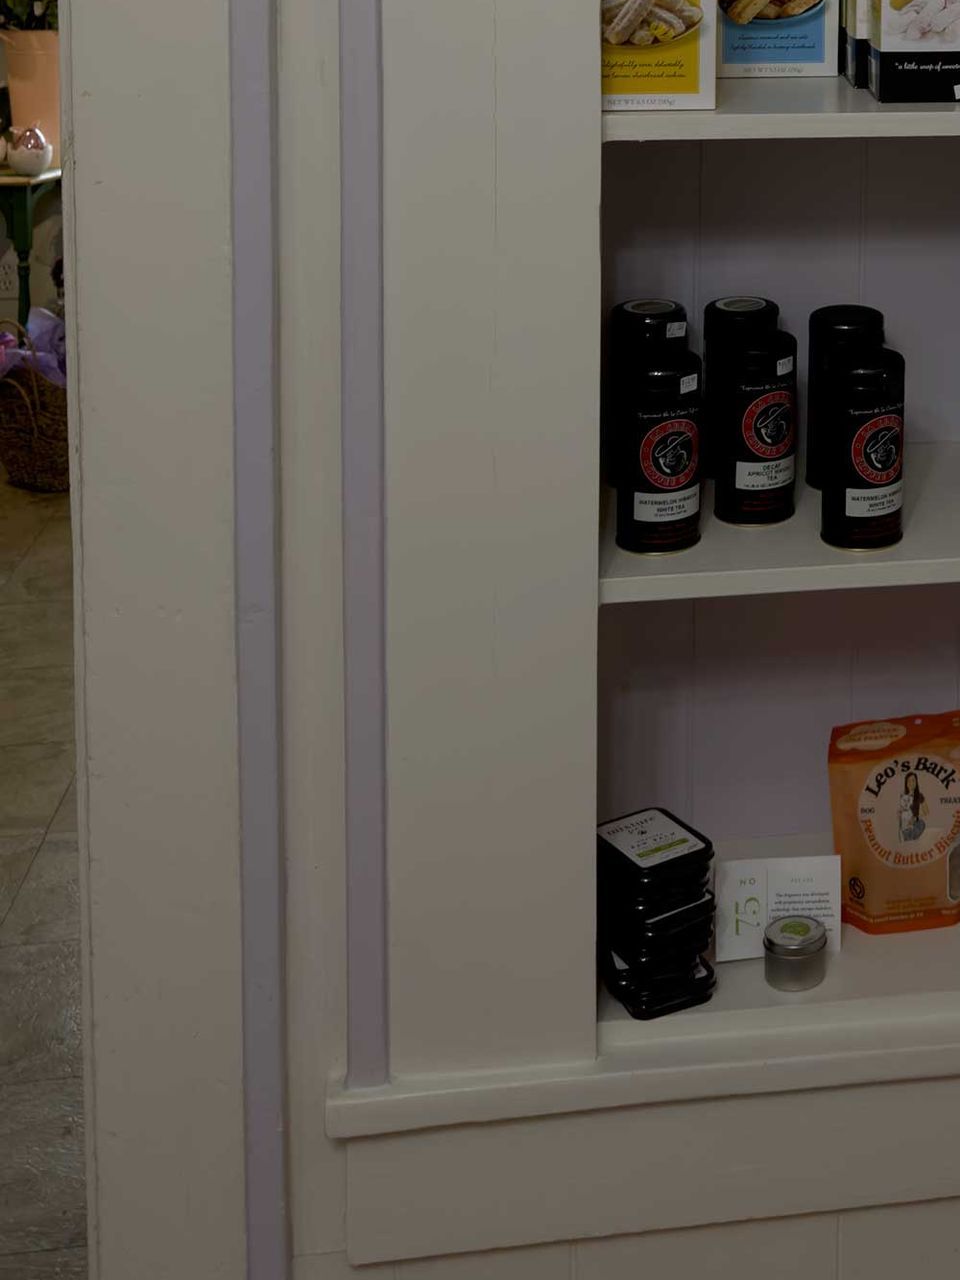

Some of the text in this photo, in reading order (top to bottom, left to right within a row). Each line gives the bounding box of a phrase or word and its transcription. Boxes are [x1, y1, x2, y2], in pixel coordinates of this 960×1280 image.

[865, 757, 957, 797] Leo's Bark
[861, 819, 892, 862] Peanut
[893, 850, 935, 866] Butter
